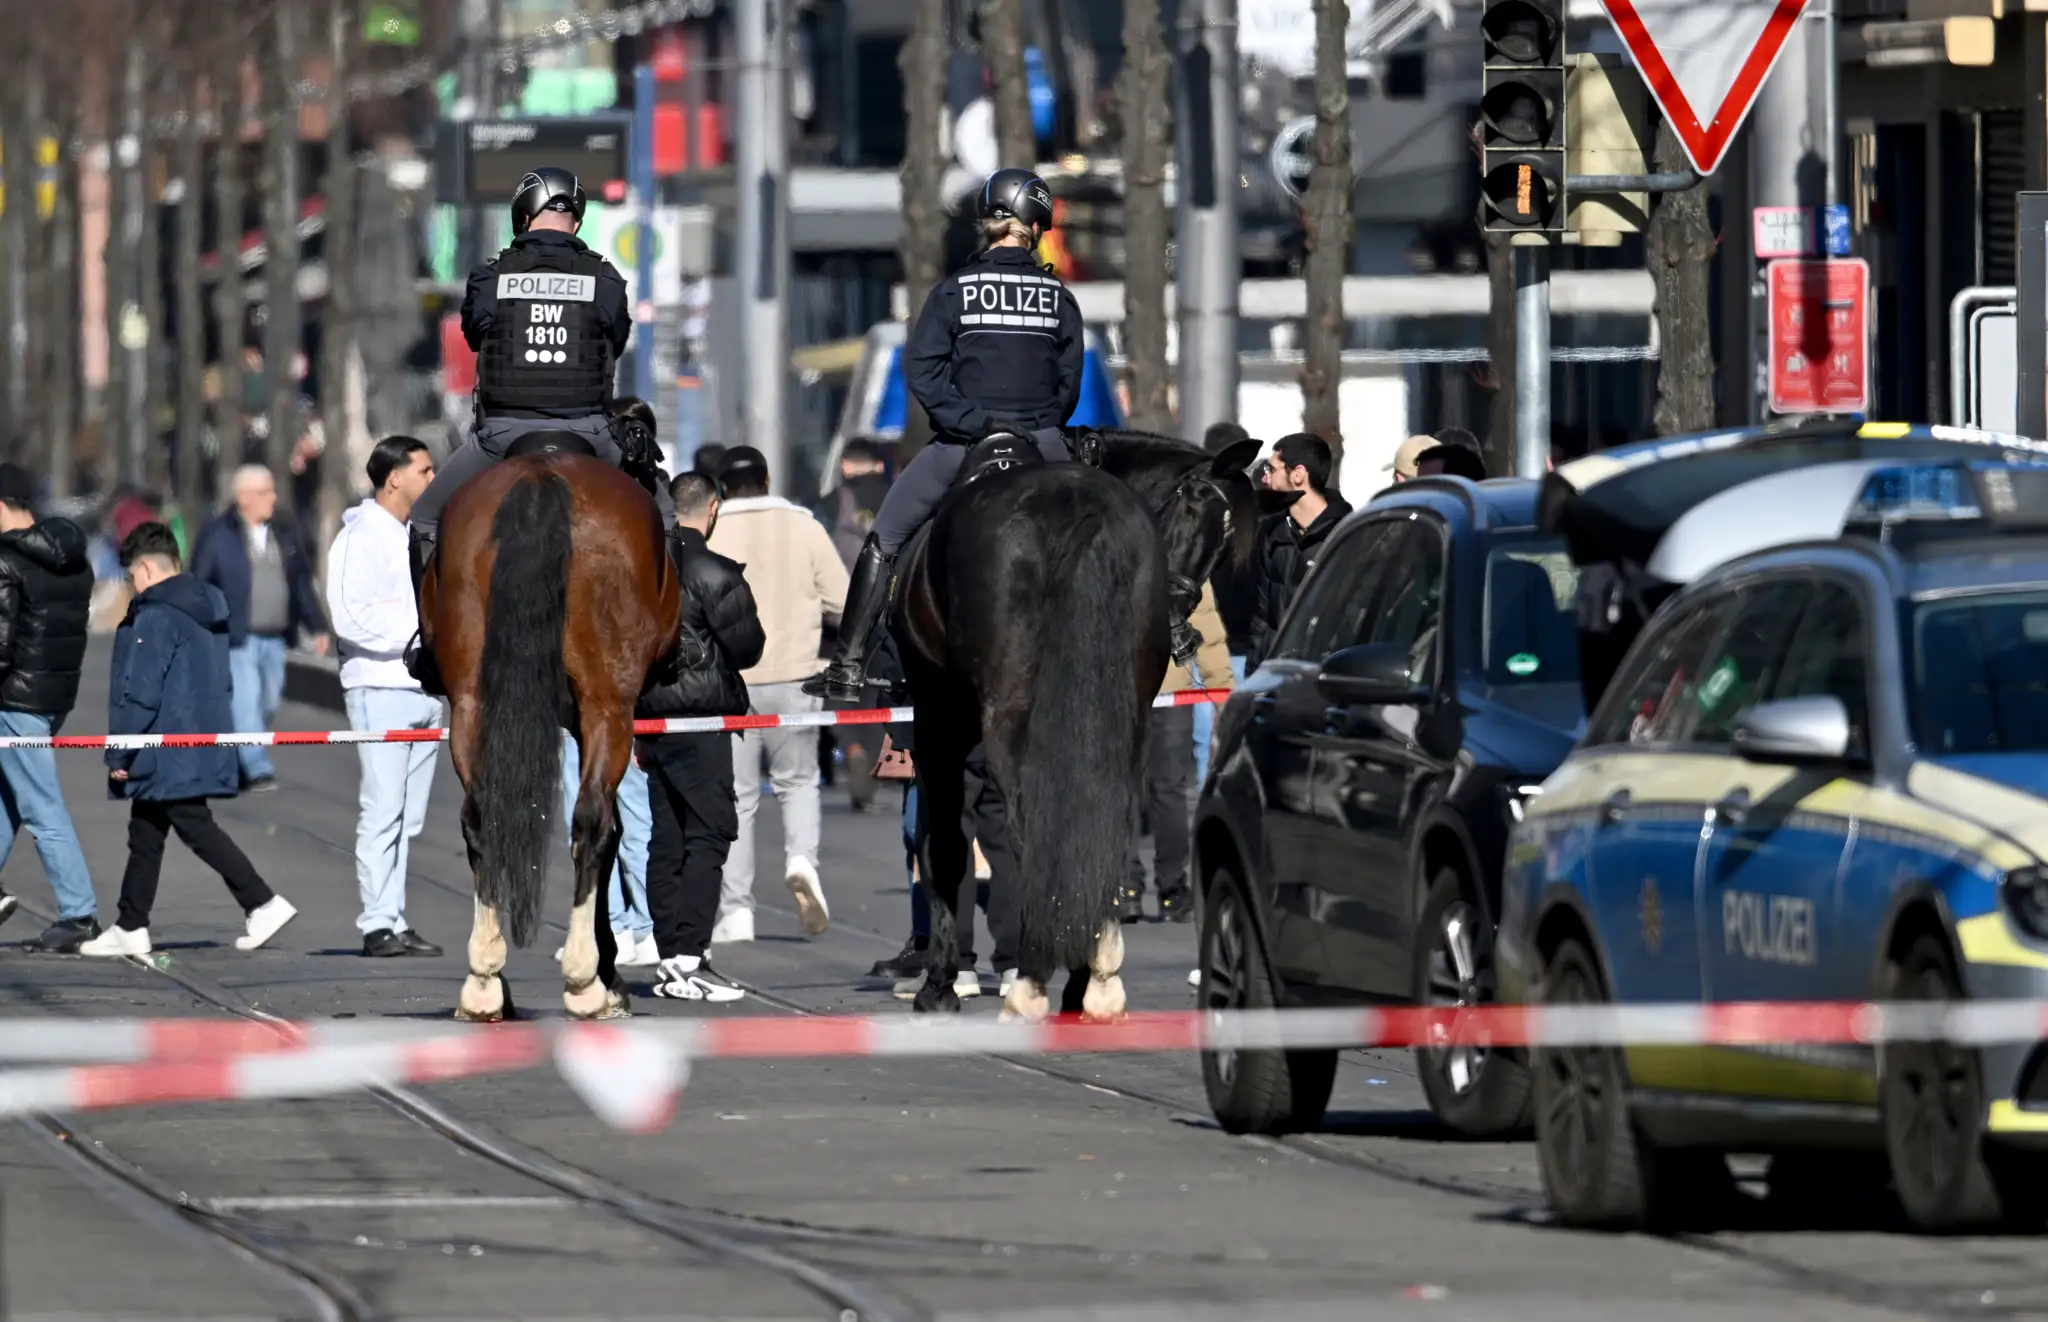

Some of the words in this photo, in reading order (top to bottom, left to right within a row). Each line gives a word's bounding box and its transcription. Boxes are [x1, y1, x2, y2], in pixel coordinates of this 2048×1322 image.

[507, 277, 584, 296] POLIZEI
[963, 284, 1059, 315] POLIZEI
[530, 303, 564, 323] BW
[525, 326, 568, 345] 1810
[1722, 889, 1818, 967] POLIZEI
